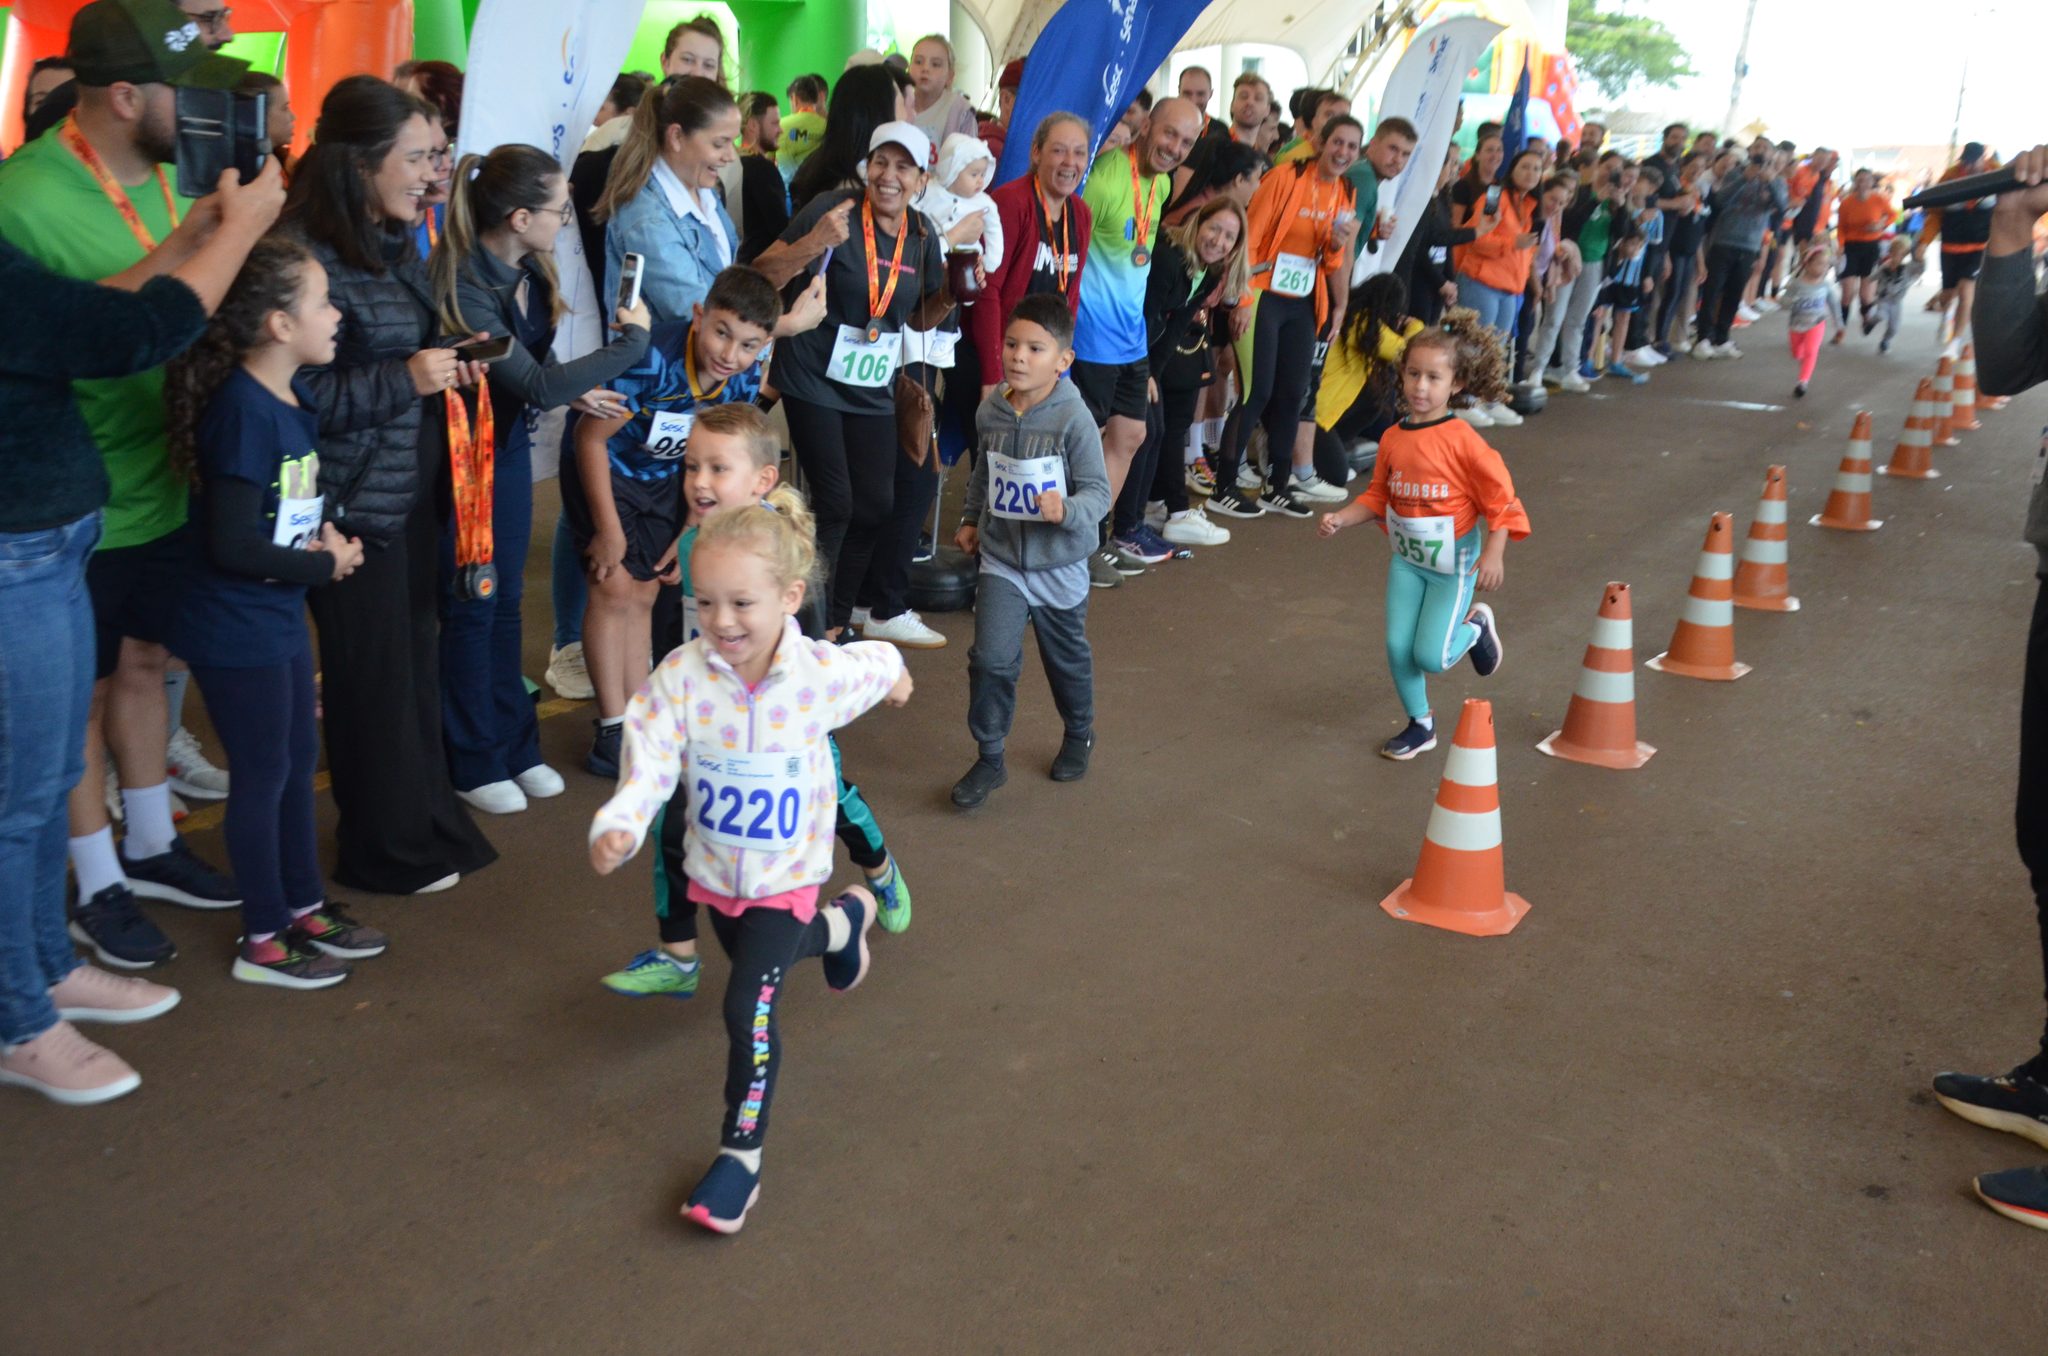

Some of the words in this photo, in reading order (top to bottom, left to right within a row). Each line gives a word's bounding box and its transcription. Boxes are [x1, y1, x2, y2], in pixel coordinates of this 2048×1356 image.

[1278, 268, 1310, 292] 261
[842, 351, 890, 382] 106
[1394, 531, 1443, 567] 357
[697, 778, 800, 839] 2220
